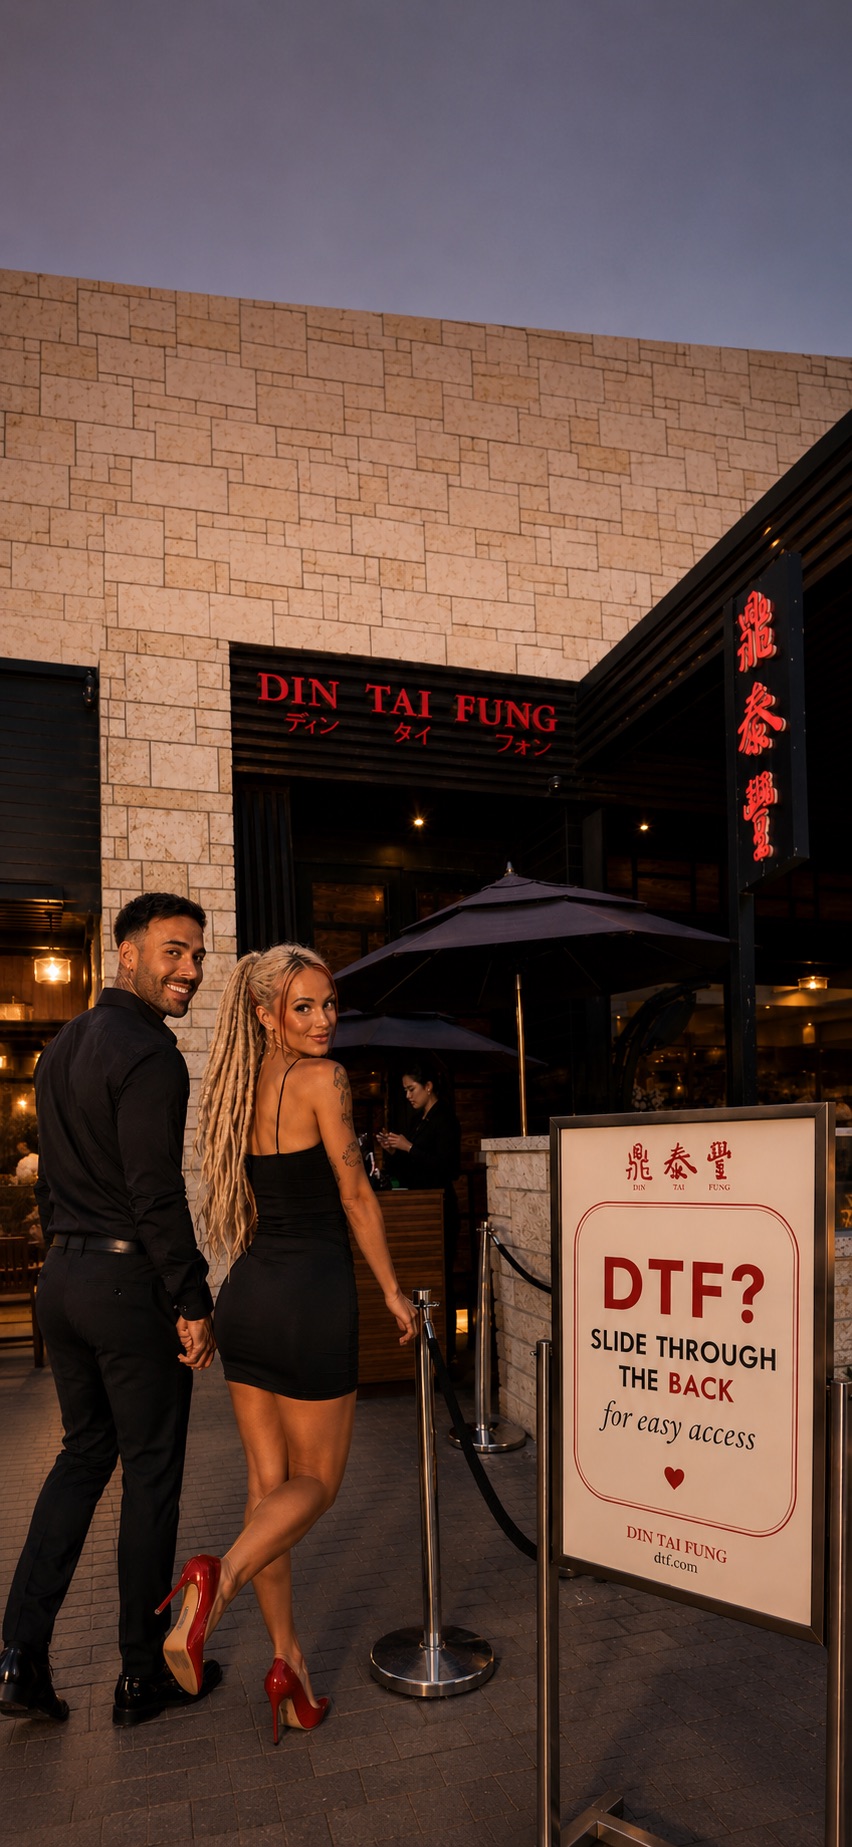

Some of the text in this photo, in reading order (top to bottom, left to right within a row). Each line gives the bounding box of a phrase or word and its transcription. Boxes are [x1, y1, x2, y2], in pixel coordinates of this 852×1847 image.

[257, 672, 559, 733] DIN TAI FUNG
[284, 712, 552, 757] ディン タイ フォン
[603, 1255, 765, 1324] DTF?
[590, 1328, 776, 1372] SLIDE THROUGH
[618, 1365, 734, 1403] THE BACK
[598, 1400, 756, 1451] for easy access
[626, 1525, 727, 1564] DIN TAI FUNG
[653, 1551, 698, 1574] dtf.com
